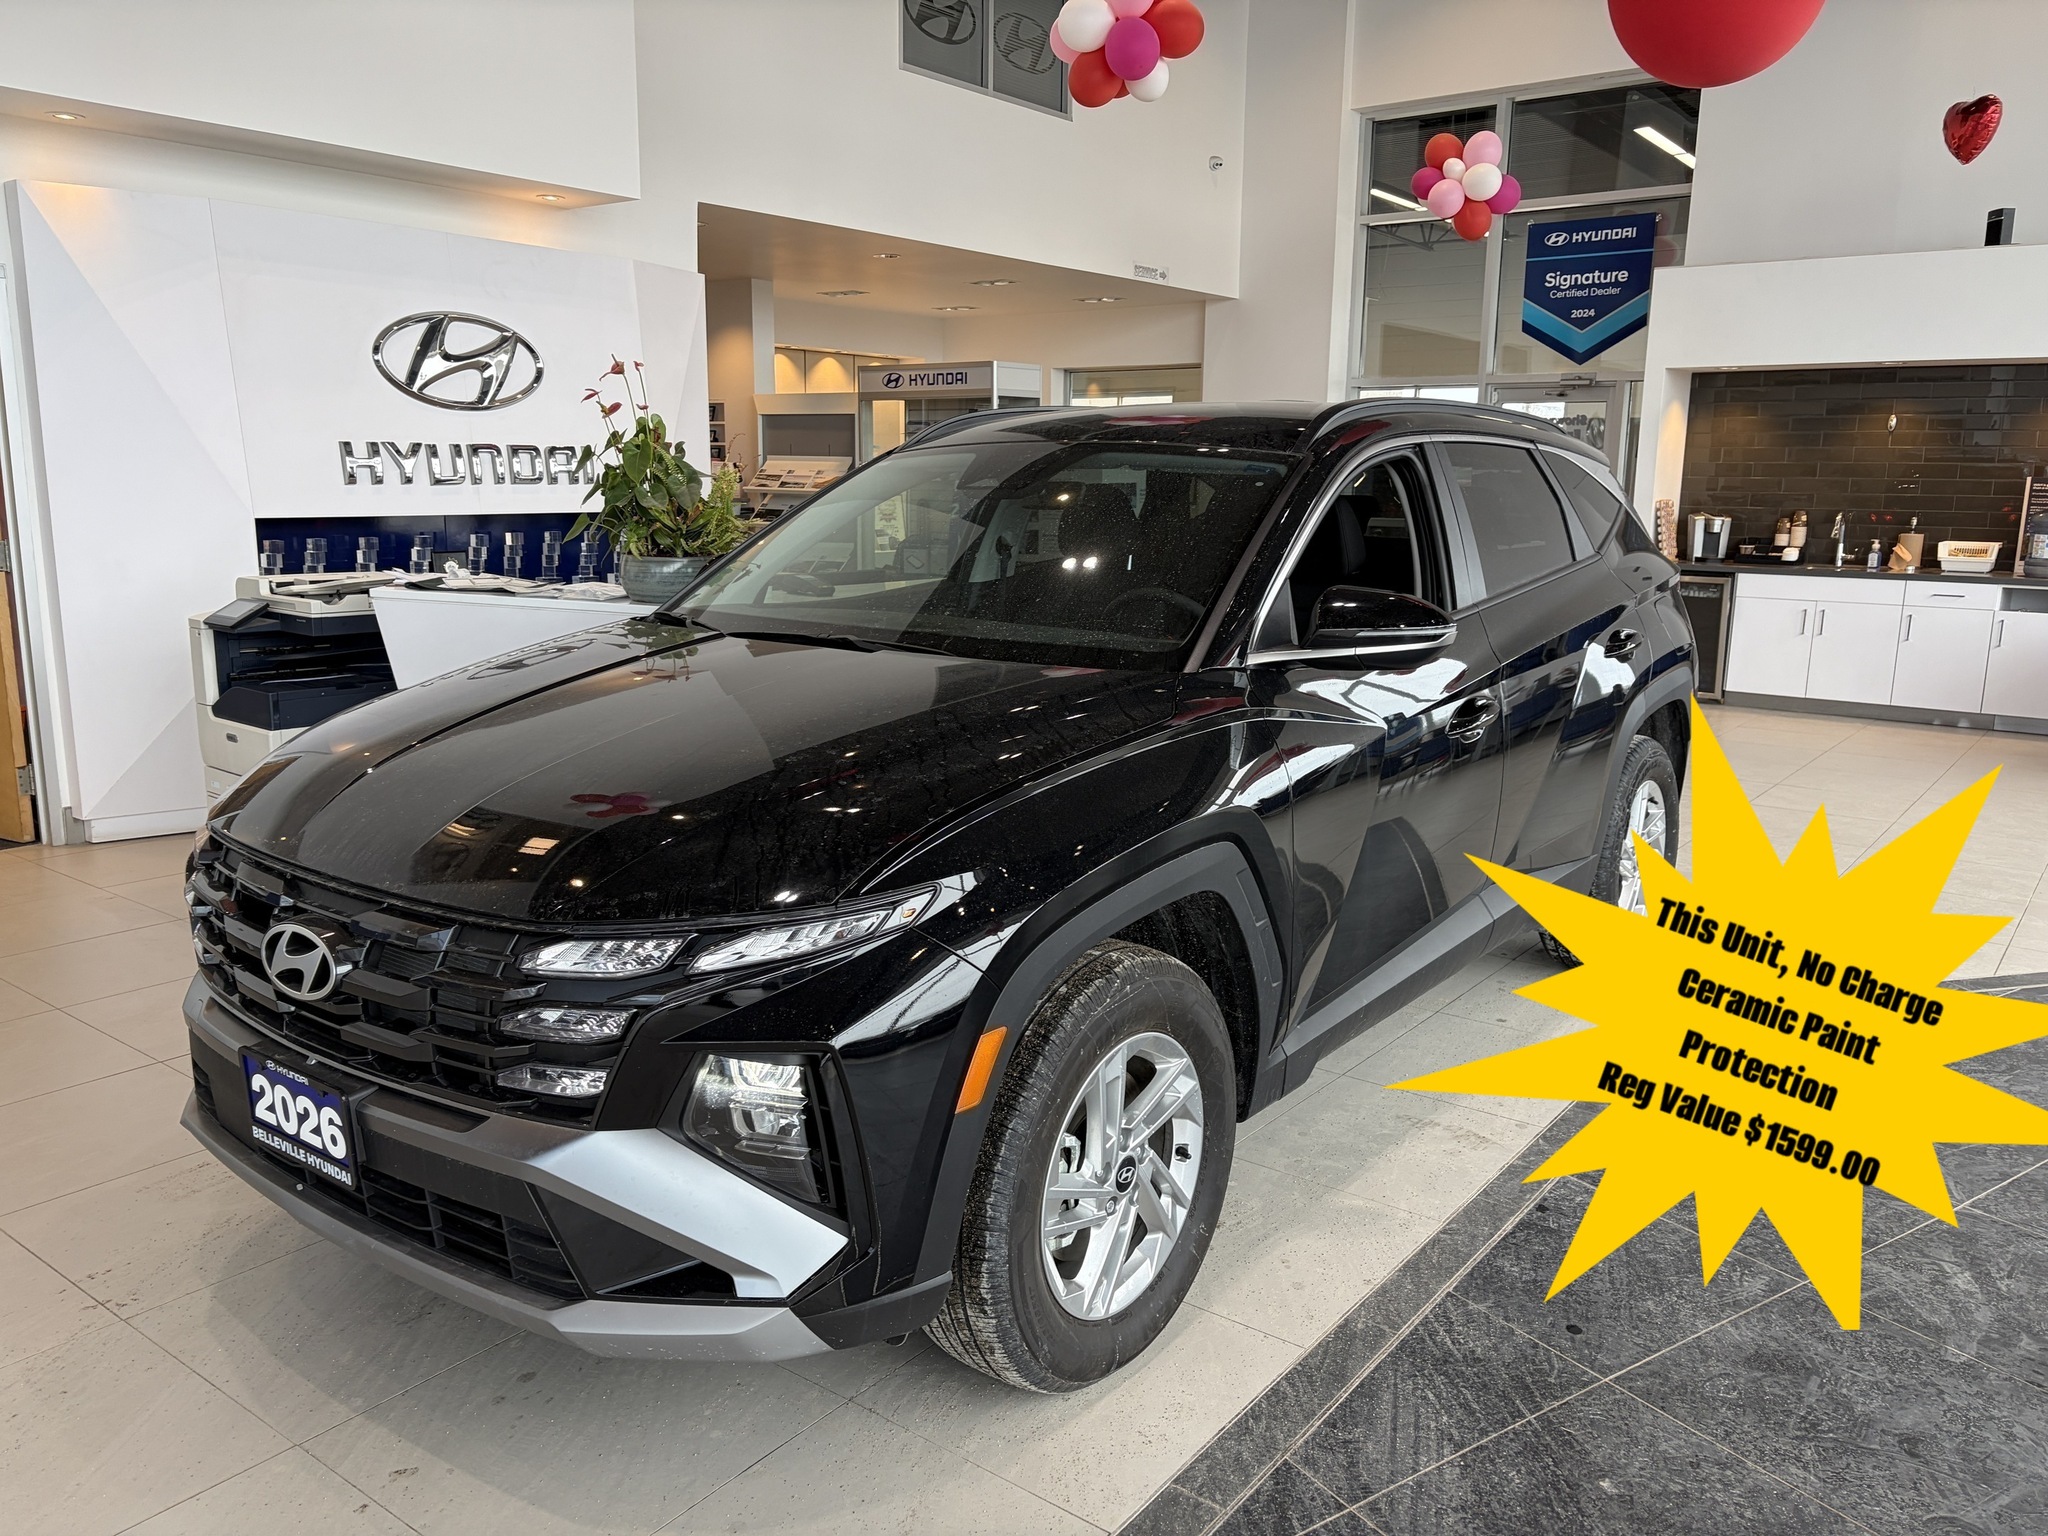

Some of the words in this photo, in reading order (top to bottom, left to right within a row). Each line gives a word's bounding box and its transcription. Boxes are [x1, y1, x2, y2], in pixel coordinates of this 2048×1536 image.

[1572, 227, 1637, 243] HYUNDAI
[1544, 270, 1629, 289] Signature
[1549, 289, 1588, 299] Certified
[1590, 286, 1621, 296] Dealer
[1570, 308, 1596, 318] 2024
[909, 372, 968, 387] HYUNDAI
[338, 441, 595, 486] HYUNDAI
[276, 1065, 309, 1086] HYUNDAI
[252, 1074, 347, 1159] 2026
[252, 1125, 307, 1162] BELLEVILLE
[307, 1152, 352, 1186] HYUNDAI
